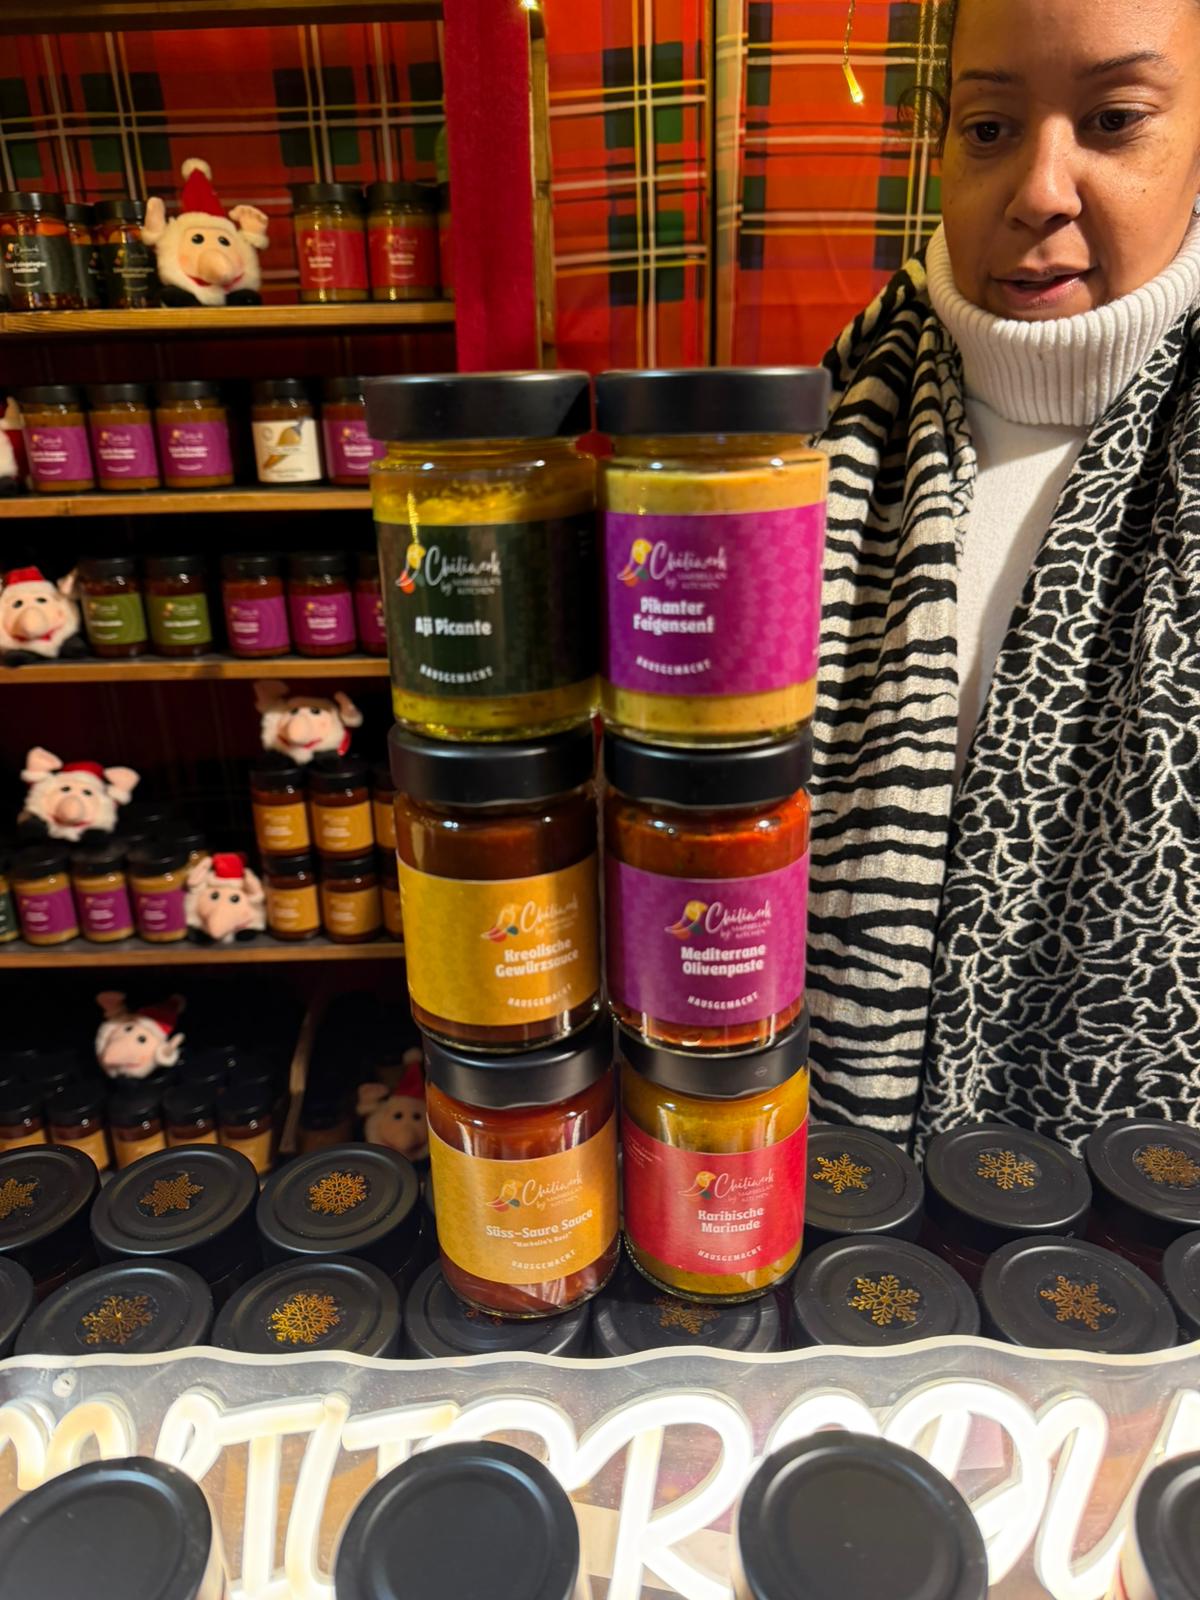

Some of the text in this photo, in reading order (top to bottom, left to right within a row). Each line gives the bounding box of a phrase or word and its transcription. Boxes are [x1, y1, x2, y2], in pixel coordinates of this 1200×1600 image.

[640, 596, 705, 615] Pikanter
[434, 617, 492, 636] Picante
[633, 613, 715, 636] Feigensenf
[420, 663, 493, 683] HAUSGEMACHT
[636, 655, 711, 675] HAUSGEMACHT
[504, 938, 572, 962] Kreolische
[681, 944, 766, 961] Mediterrane
[495, 949, 579, 977] Gewürzsauce
[682, 959, 765, 979] Olivenpaste
[507, 982, 572, 1008] HAUSGEMACHT
[687, 991, 758, 1010] HAUSGEMACHT
[485, 1209, 593, 1239] Süss-Saure Sauce
[697, 1207, 765, 1222] Karibische
[701, 1220, 761, 1234] Marinade
[511, 1249, 576, 1270] HAUSGEMACHT
[697, 1245, 762, 1262] HAUSGEMACHT
